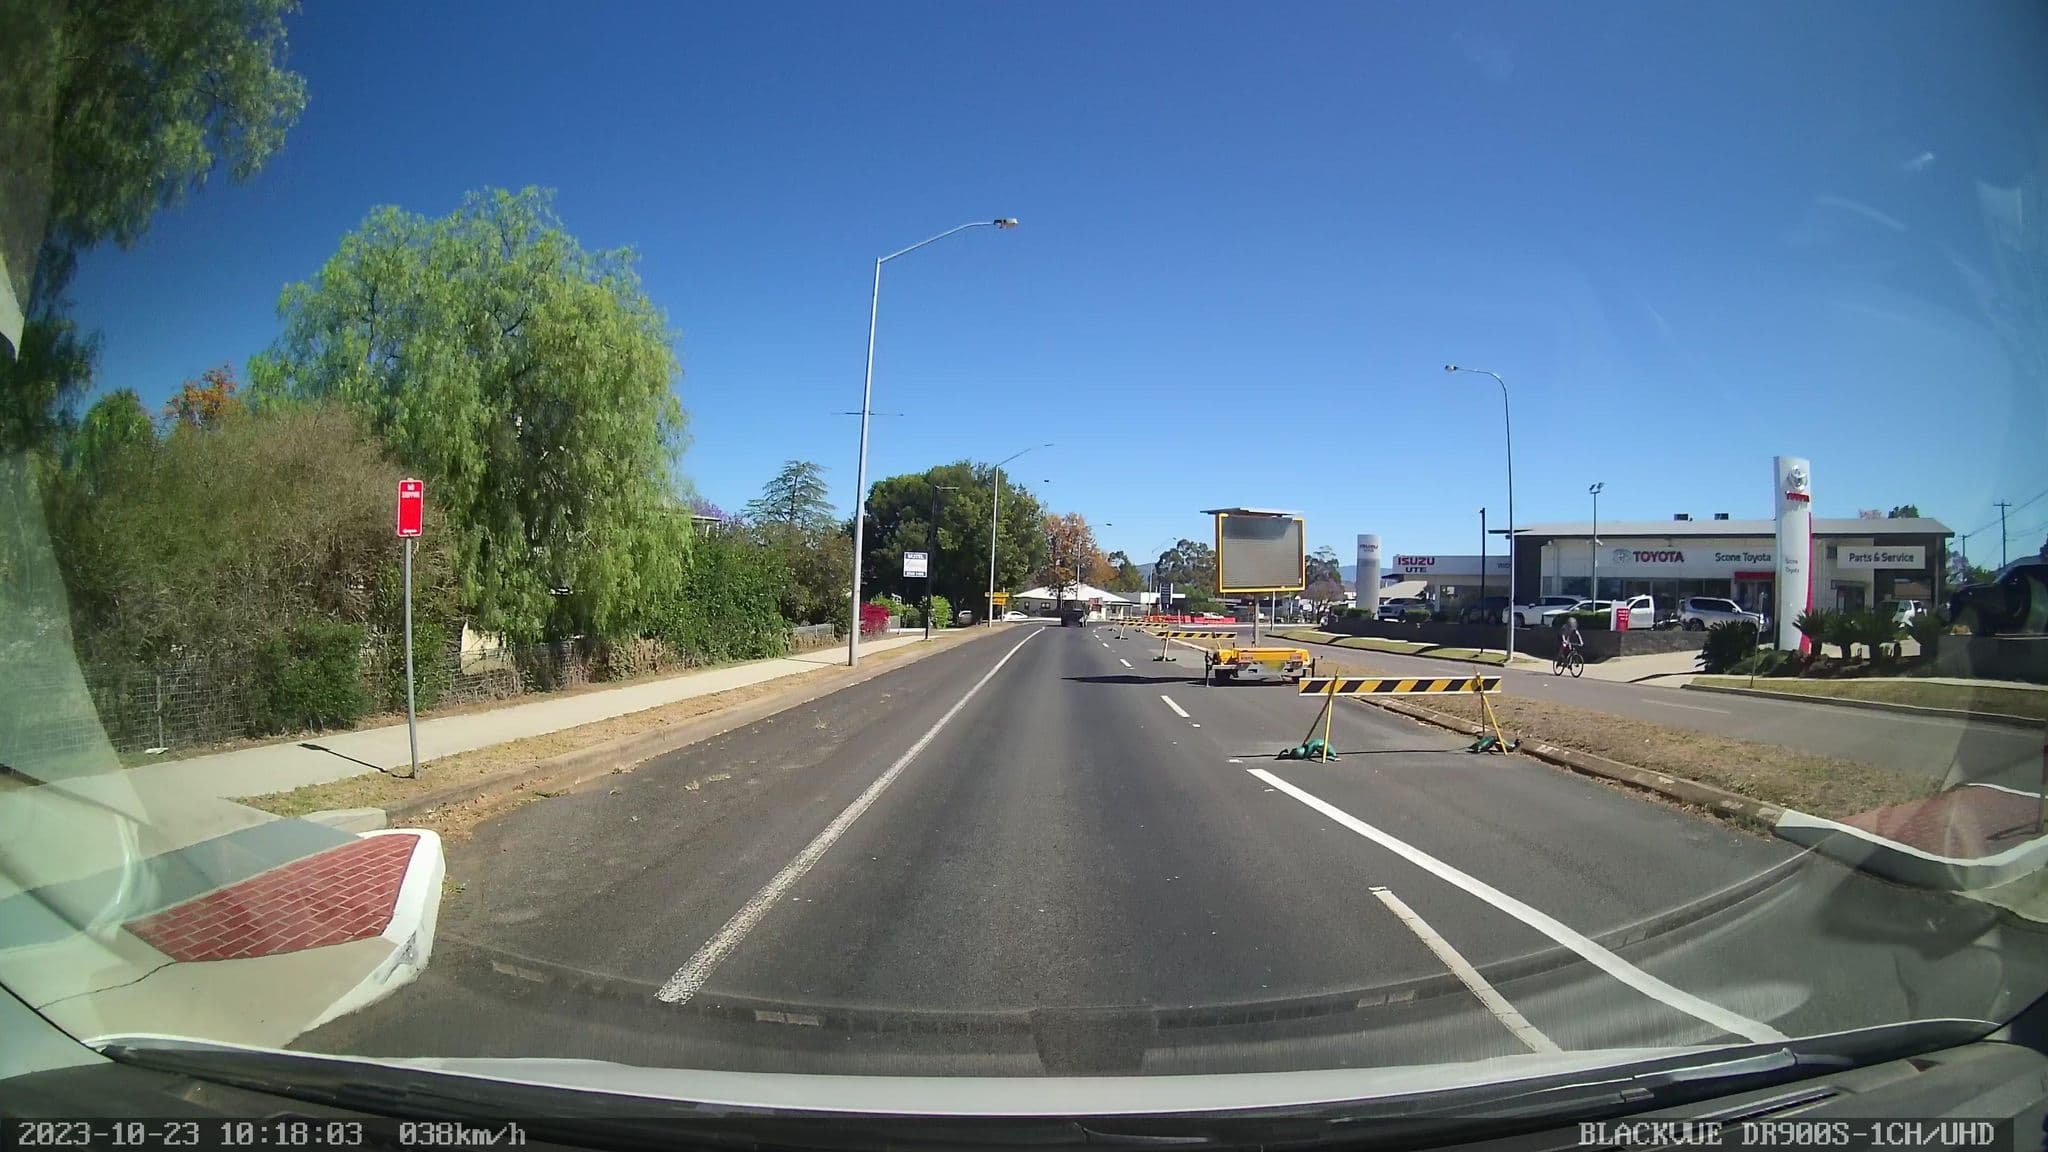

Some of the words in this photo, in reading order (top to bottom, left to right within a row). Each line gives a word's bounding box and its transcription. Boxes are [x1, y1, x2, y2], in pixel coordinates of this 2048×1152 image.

[1398, 557, 1435, 566] ISUZU
[1633, 551, 1685, 563] TOYOTA
[1715, 553, 1741, 562] Scone
[1743, 553, 1771, 564] Toyota
[1849, 553, 1872, 562] Parts
[1873, 553, 1881, 562] &
[1881, 553, 1914, 562] Service
